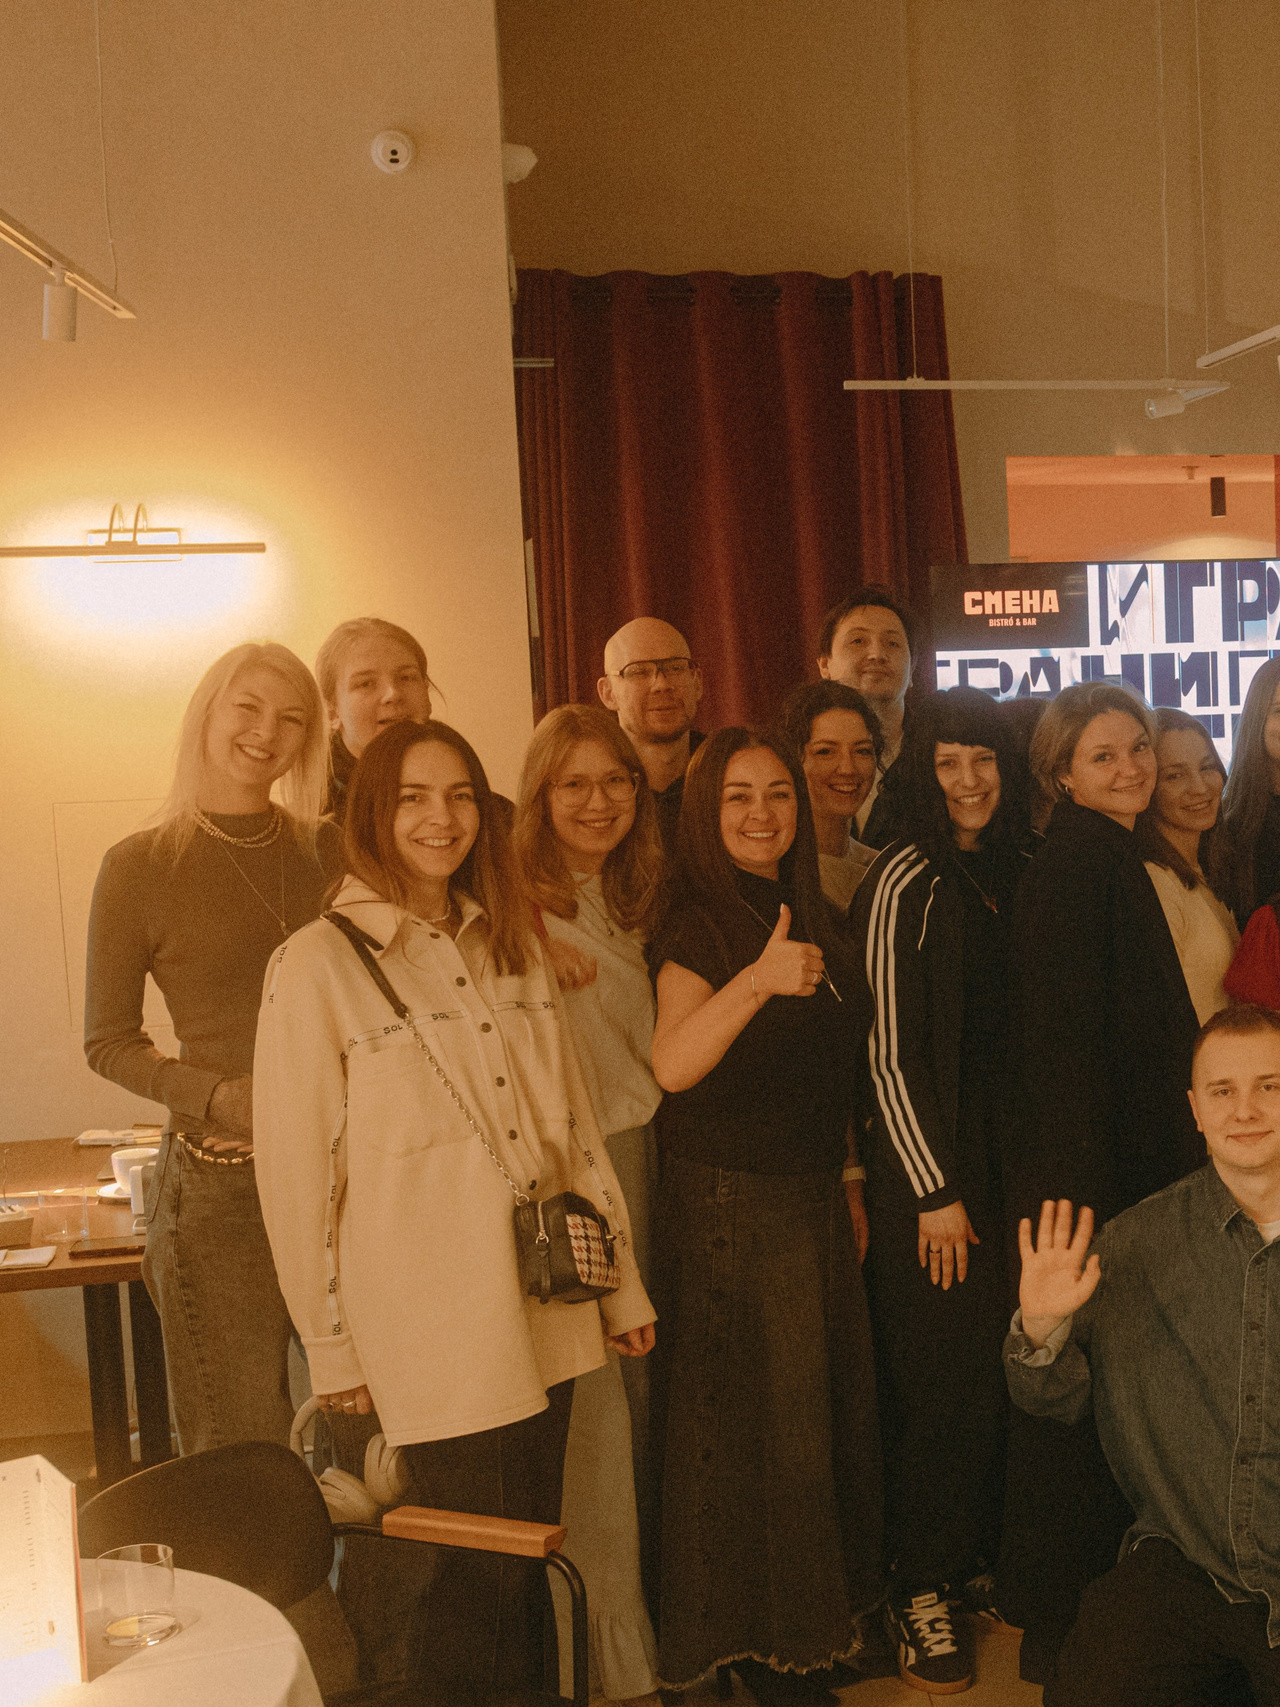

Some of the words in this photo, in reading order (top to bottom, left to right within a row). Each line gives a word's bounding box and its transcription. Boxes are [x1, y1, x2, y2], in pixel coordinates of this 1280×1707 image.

[963, 589, 1060, 615] СМЕНА
[988, 616, 1014, 627] BISTRÓ
[1015, 617, 1021, 626] &
[1022, 617, 1037, 626] BAR
[383, 1024, 404, 1035] SOL
[431, 1012, 450, 1021] SOL
[584, 1150, 596, 1168] SOL
[328, 1276, 337, 1294] SOL
